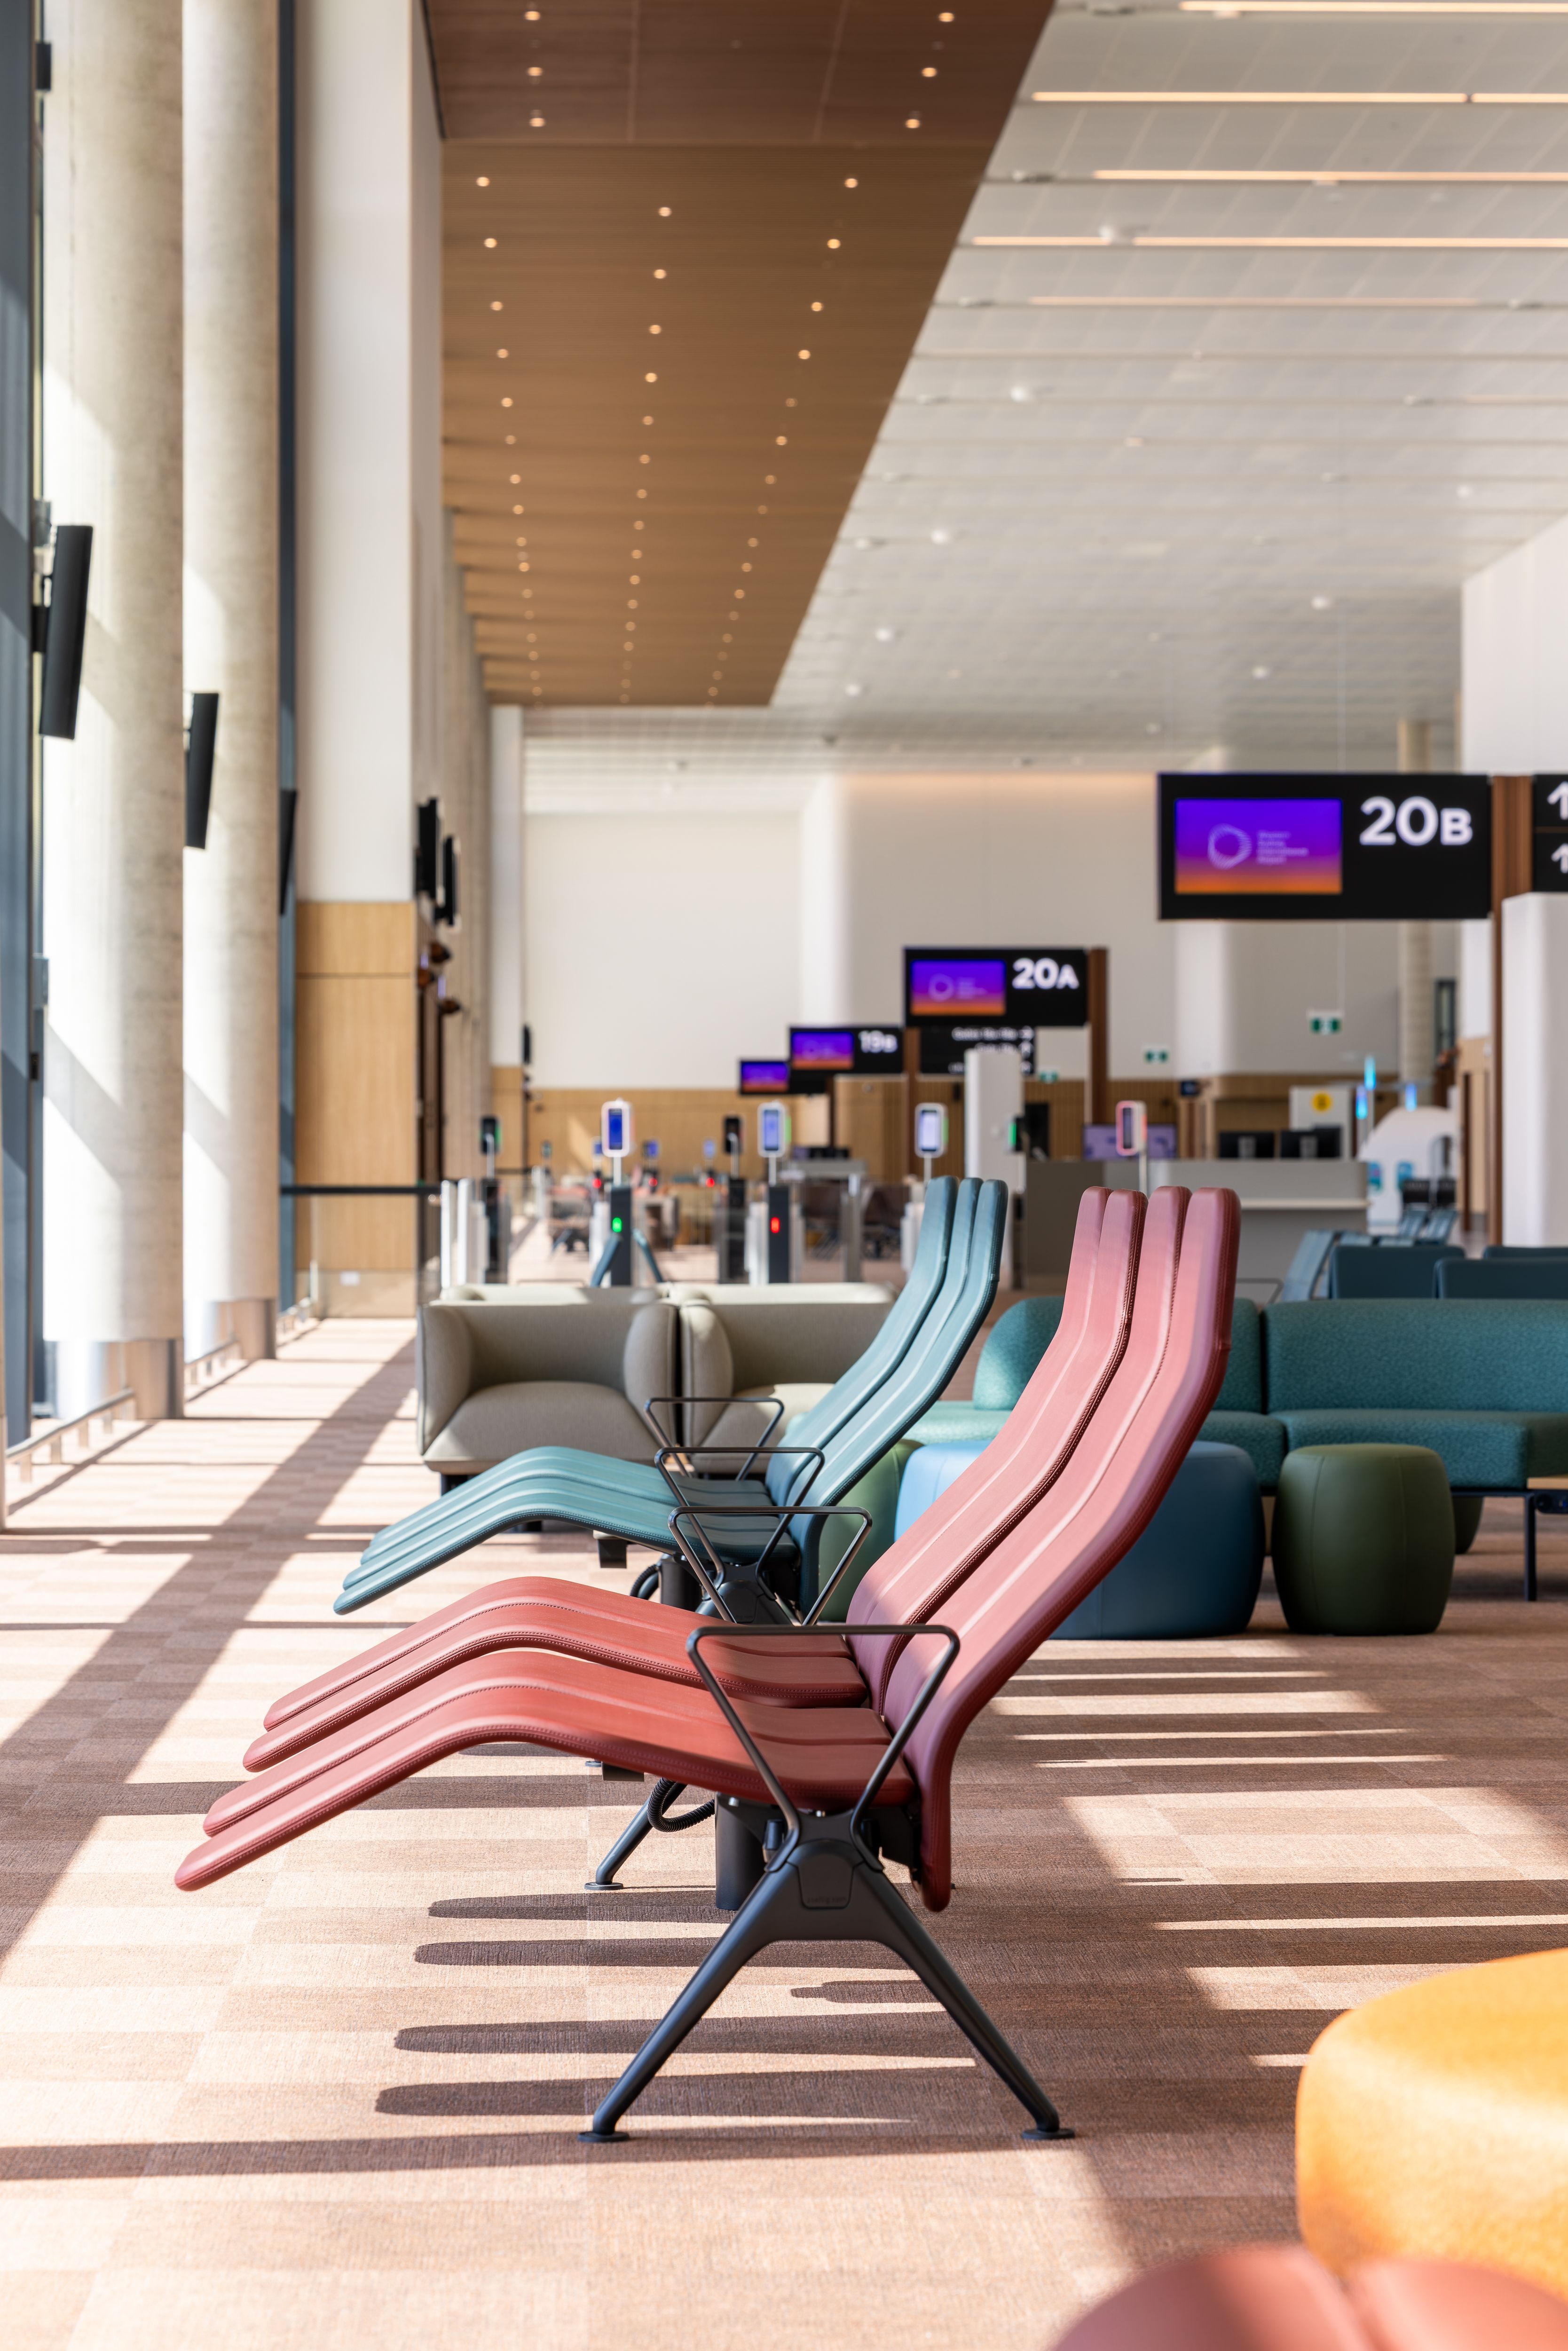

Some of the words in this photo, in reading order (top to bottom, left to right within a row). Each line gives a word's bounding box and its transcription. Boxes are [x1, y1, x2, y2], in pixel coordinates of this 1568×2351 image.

[1359, 796, 1473, 846] 20B
[1012, 958, 1079, 989] 20A
[859, 1030, 898, 1052] 19B
